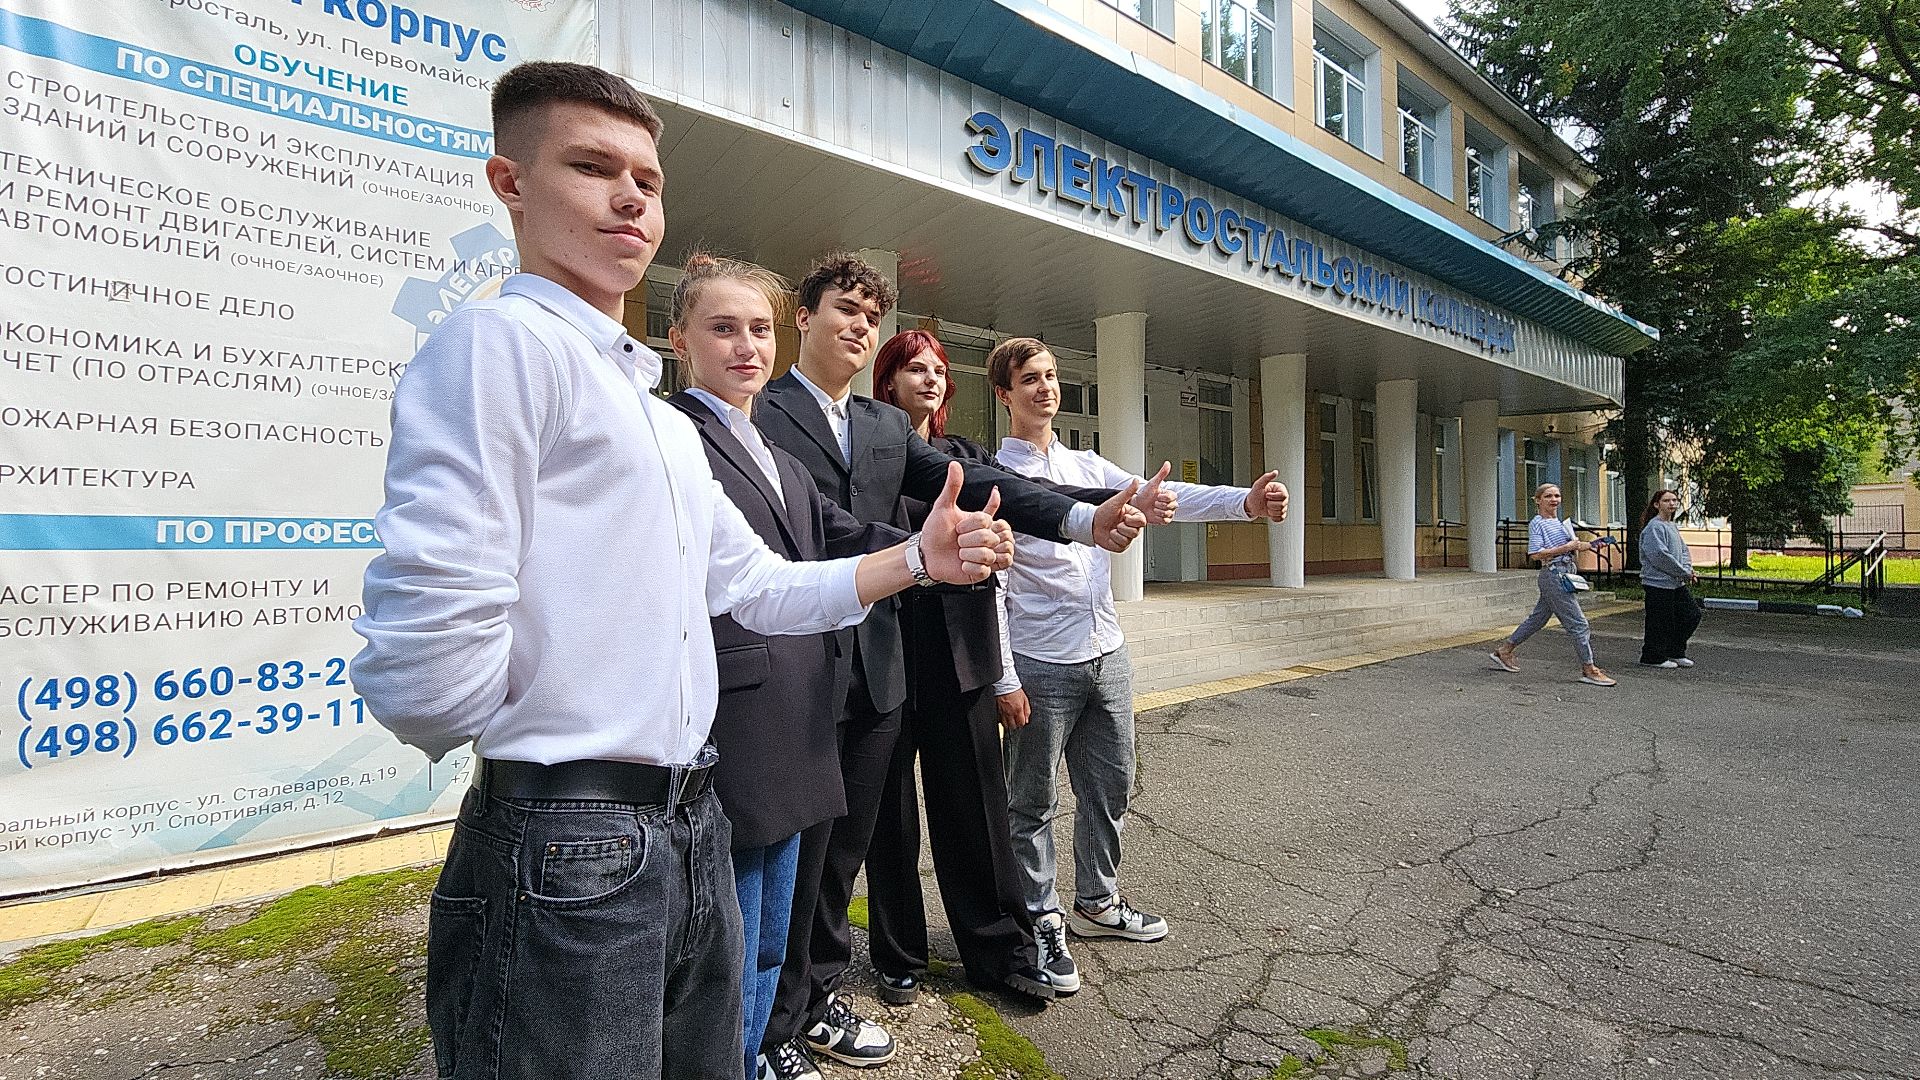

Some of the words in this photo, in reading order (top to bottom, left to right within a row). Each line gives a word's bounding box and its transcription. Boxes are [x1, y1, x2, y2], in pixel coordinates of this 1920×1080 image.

[296, 28, 332, 50] ул.
[116, 46, 170, 79] ПО
[180, 65, 495, 155] СПЕЦИАЛЬНОСТЯМ
[234, 44, 408, 106] ОБУЧЕНИЕ
[3, 96, 126, 142] ЗДАНИЙ
[138, 128, 156, 148] И
[167, 135, 354, 189] СООРУЖЕНИЙ
[362, 181, 495, 217] (ОЧНОЕ/ЗАОЧНОЕ)
[7, 70, 249, 143] СТРОИТЕЛЬСТВО
[259, 131, 277, 150] И
[286, 137, 474, 189] ЭКСПЛУАТАЦИЯ
[0, 151, 211, 210] ТЕХНИЧЕСКОЕ
[220, 197, 432, 248] ОБСЛУЖИВАНИЕ
[0, 180, 14, 200] И
[26, 184, 152, 224] РЕМОНТ
[159, 210, 342, 259] ДВИГАТЕЛЕЙ,
[350, 243, 445, 273] СИСТЕМ
[453, 259, 467, 274] И
[0, 207, 220, 262] АВТОМОБИЛЕЙ
[230, 252, 384, 289] (ОЧНОЕ/ЗАОЧНОЕ)
[965, 112, 1411, 315] ЭЛЕКТРОСТАЛЬСКИЙ
[1416, 287, 1516, 353] КОЛЛЕДЖ
[0, 264, 210, 311] ОСТИНИЧНОЕ
[219, 296, 295, 321] ДЕЛО
[0, 321, 183, 359] КОНОМИКА
[194, 343, 211, 361] И
[223, 345, 408, 379] БУХГАЛТЕРСК
[3, 349, 63, 373] ЧЕТ
[72, 355, 126, 381] (ПО
[138, 364, 302, 398] ОТРАСЛЯМ)
[2, 407, 158, 436] ОЖАРНАЯ
[170, 419, 385, 448] БЕЗОПАСНОСТЬ
[0, 464, 196, 490] РХИТЕКТУРА
[156, 519, 214, 544] ПО
[225, 520, 382, 544] ПРОФЕС
[0, 584, 100, 605] АСТЕР
[112, 583, 155, 603] ПО
[166, 579, 304, 601] РЕМОНТУ
[313, 578, 330, 597] И
[0, 607, 244, 638] БСЛУЖИВАНИЮ
[253, 603, 361, 627] АВТОМО
[17, 670, 138, 722] (498)
[153, 657, 346, 701] 660-83-2
[18, 716, 138, 769] (498)
[153, 697, 364, 746] 662-39-11
[0, 835, 27, 852] ый
[35, 827, 112, 848] корпус
[131, 821, 160, 838] ул.
[168, 800, 298, 829] Спортивная,
[303, 790, 344, 811] д.12
[103, 799, 179, 820] корпус
[197, 794, 226, 811] ул.
[234, 774, 354, 801] Сталеваров,
[359, 766, 397, 785] д.19
